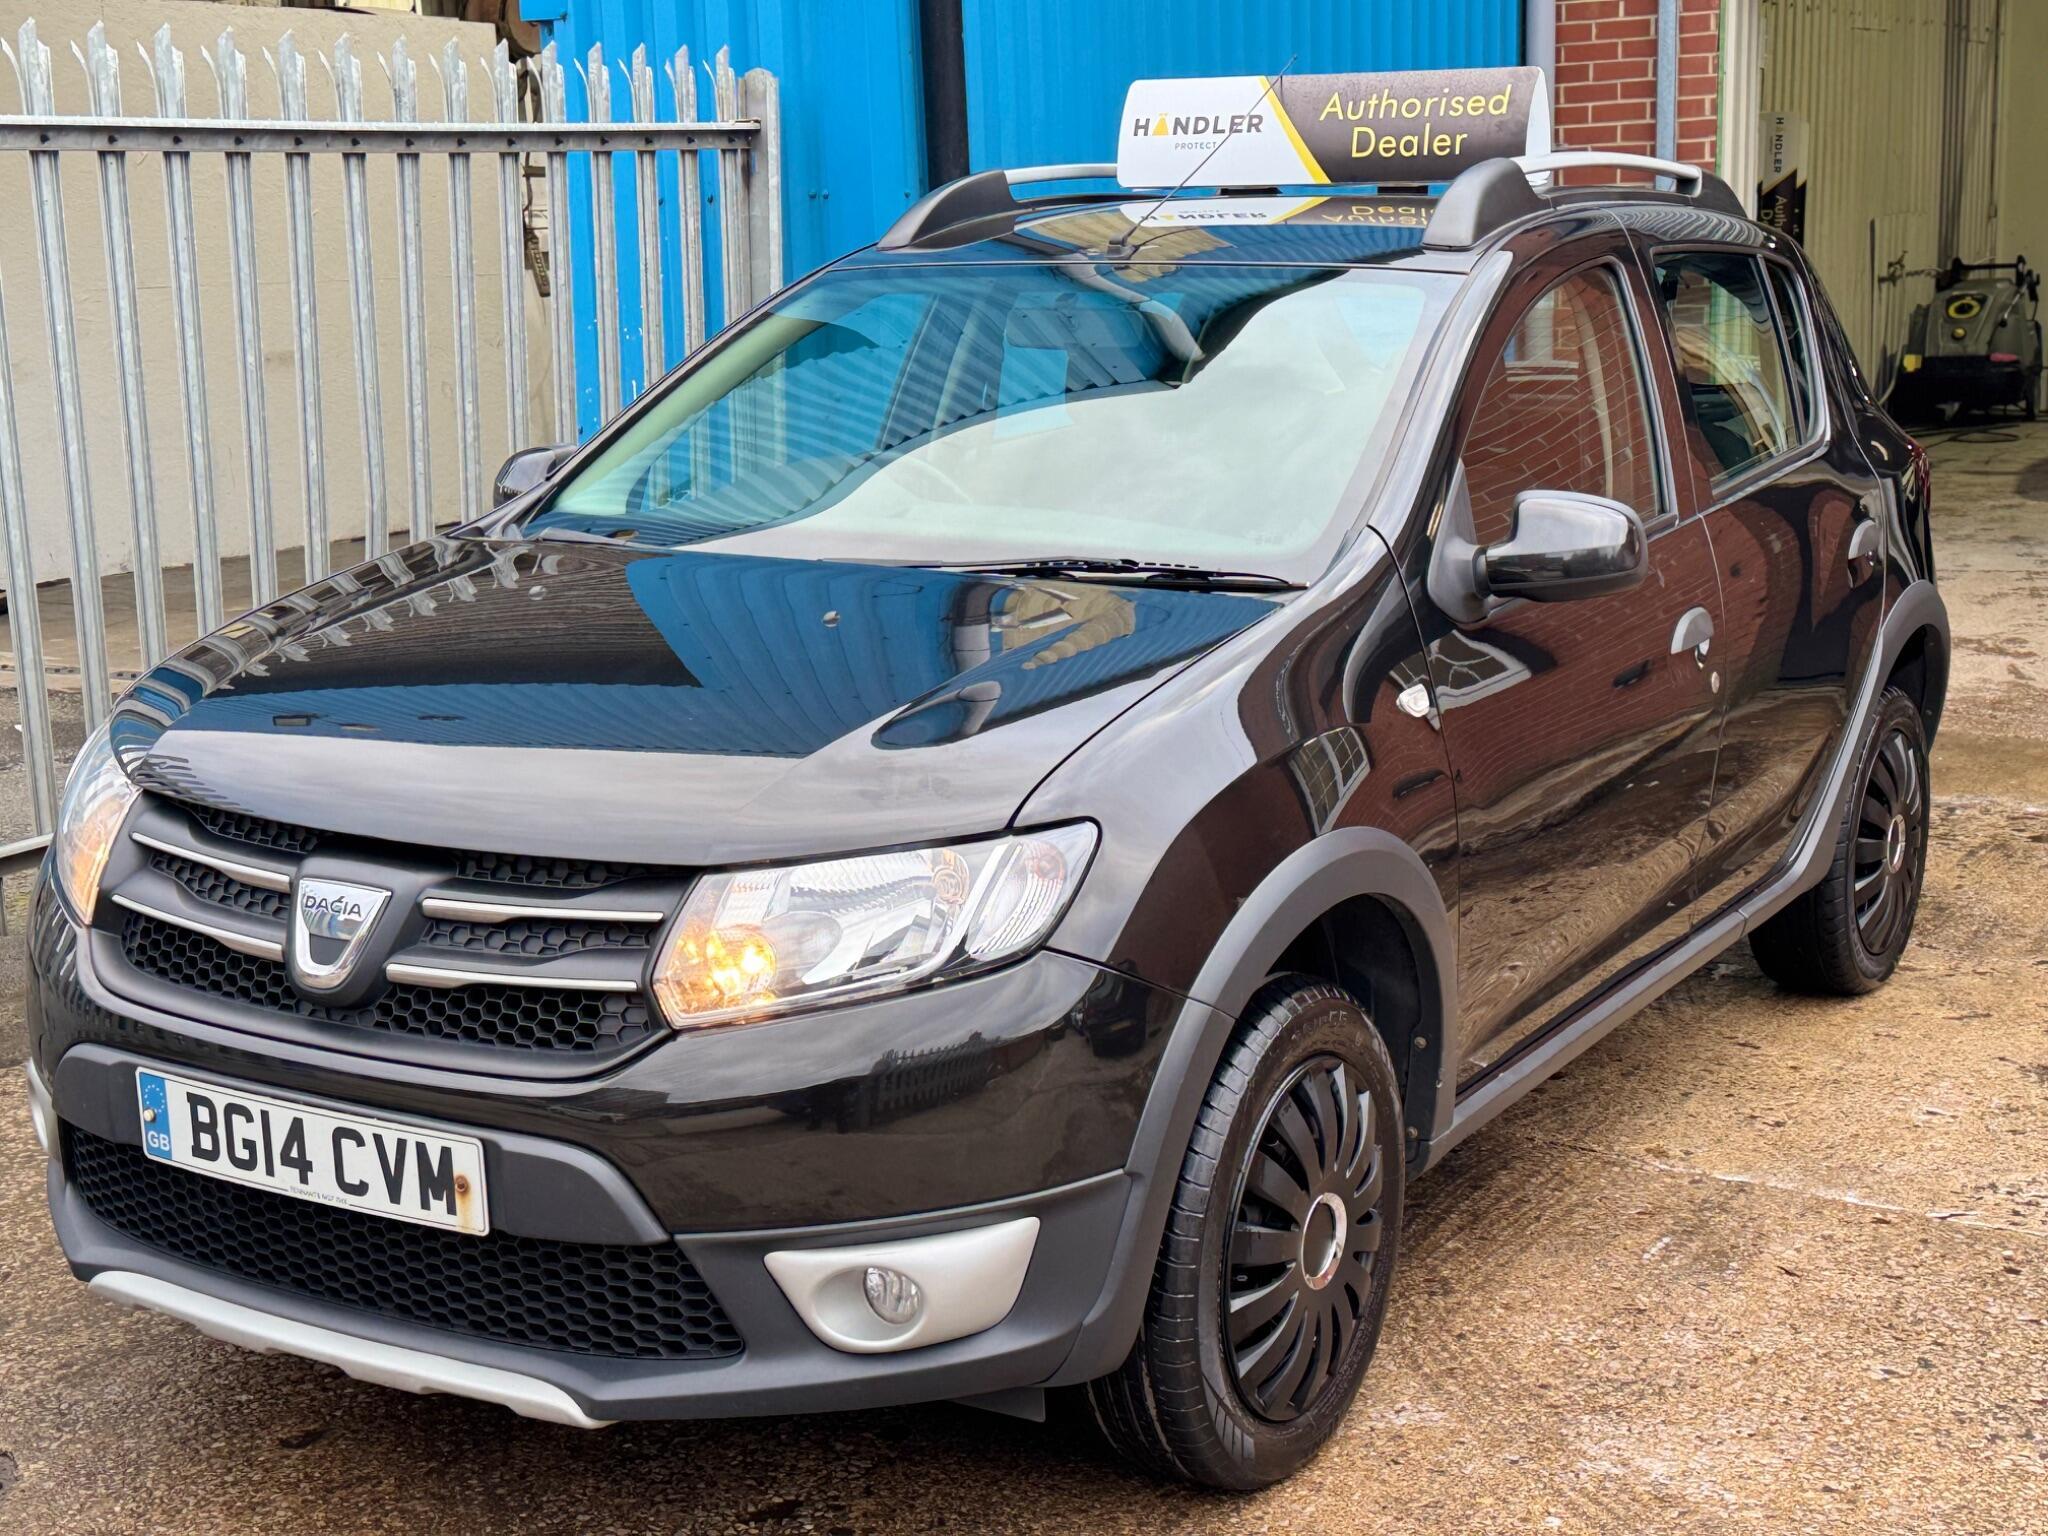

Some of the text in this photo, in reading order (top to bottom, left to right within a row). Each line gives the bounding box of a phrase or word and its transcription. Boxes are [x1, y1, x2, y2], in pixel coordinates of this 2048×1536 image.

[1319, 84, 1513, 122] Authorised
[1174, 141, 1217, 150] PROTECT
[1351, 123, 1469, 159] Dealer
[147, 1130, 171, 1152] GB
[186, 1091, 458, 1217] BG14 CVM
